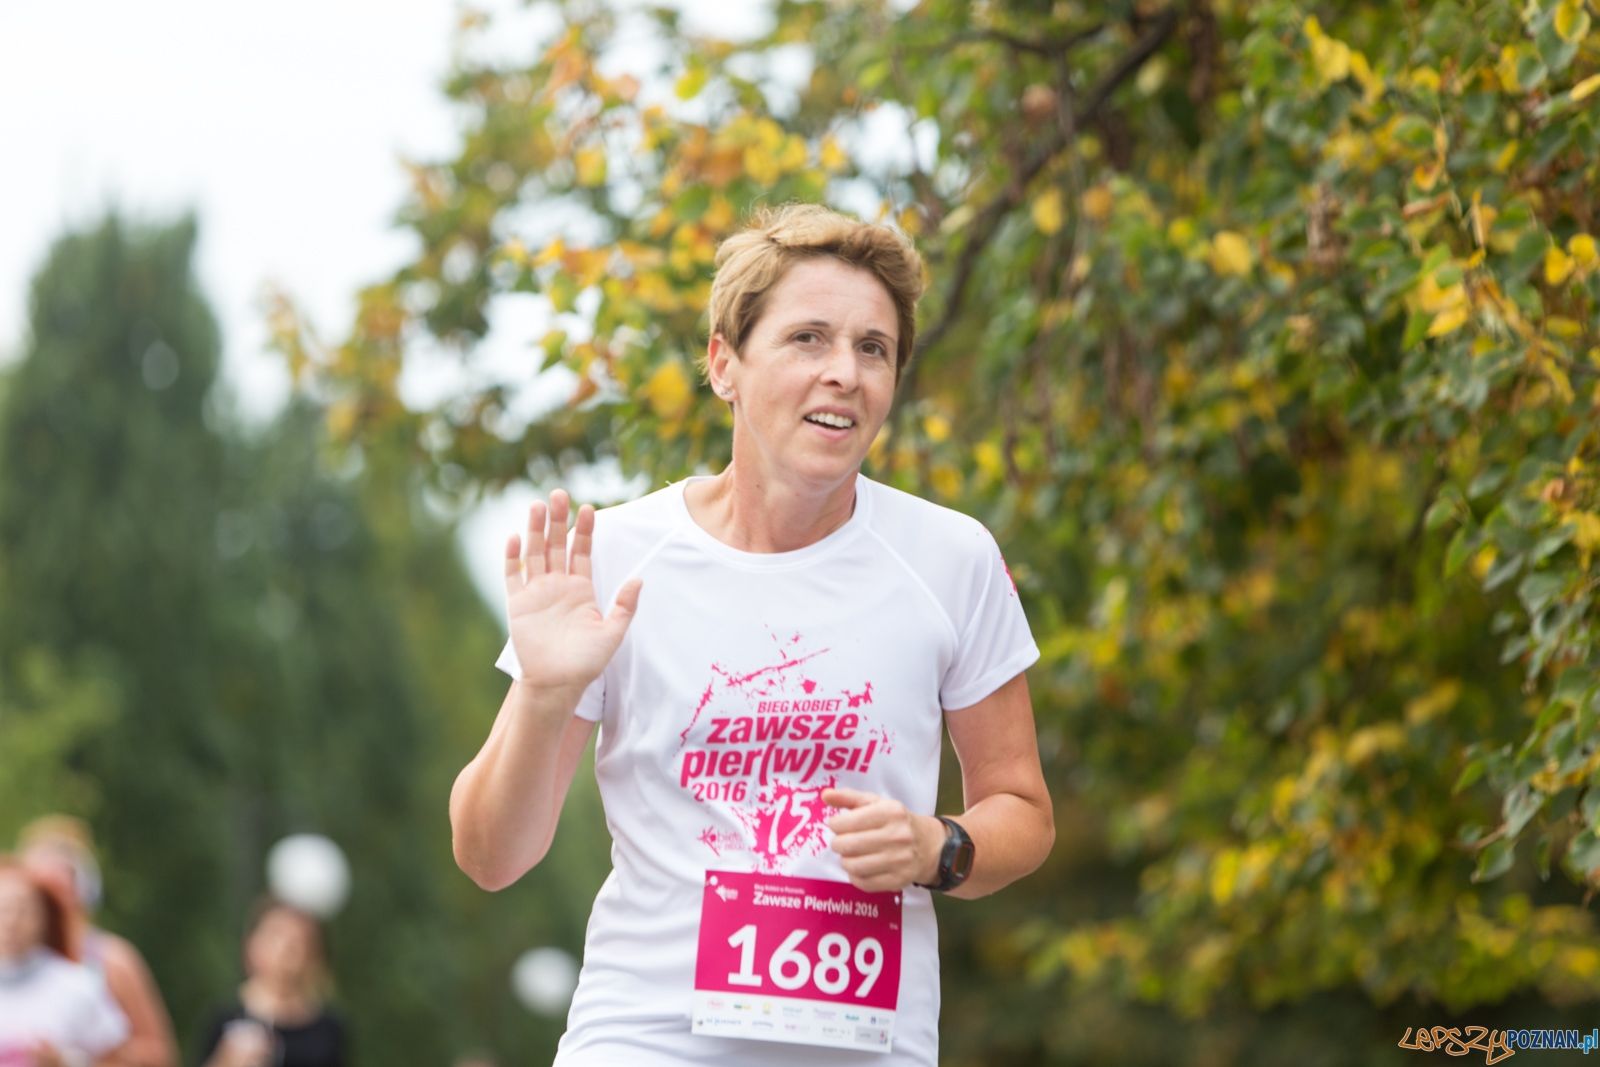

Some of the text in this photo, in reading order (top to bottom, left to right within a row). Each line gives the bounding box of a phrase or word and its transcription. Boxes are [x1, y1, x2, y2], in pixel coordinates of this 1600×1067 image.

[757, 699, 842, 714] BIEG KOBIET
[706, 713, 859, 744] zawsze
[691, 781, 748, 803] 2016
[765, 791, 819, 855] 15
[753, 891, 801, 908] Zawsze
[804, 895, 853, 916] Pier(w)si
[854, 903, 879, 918] 2016
[727, 924, 884, 998] 1689
